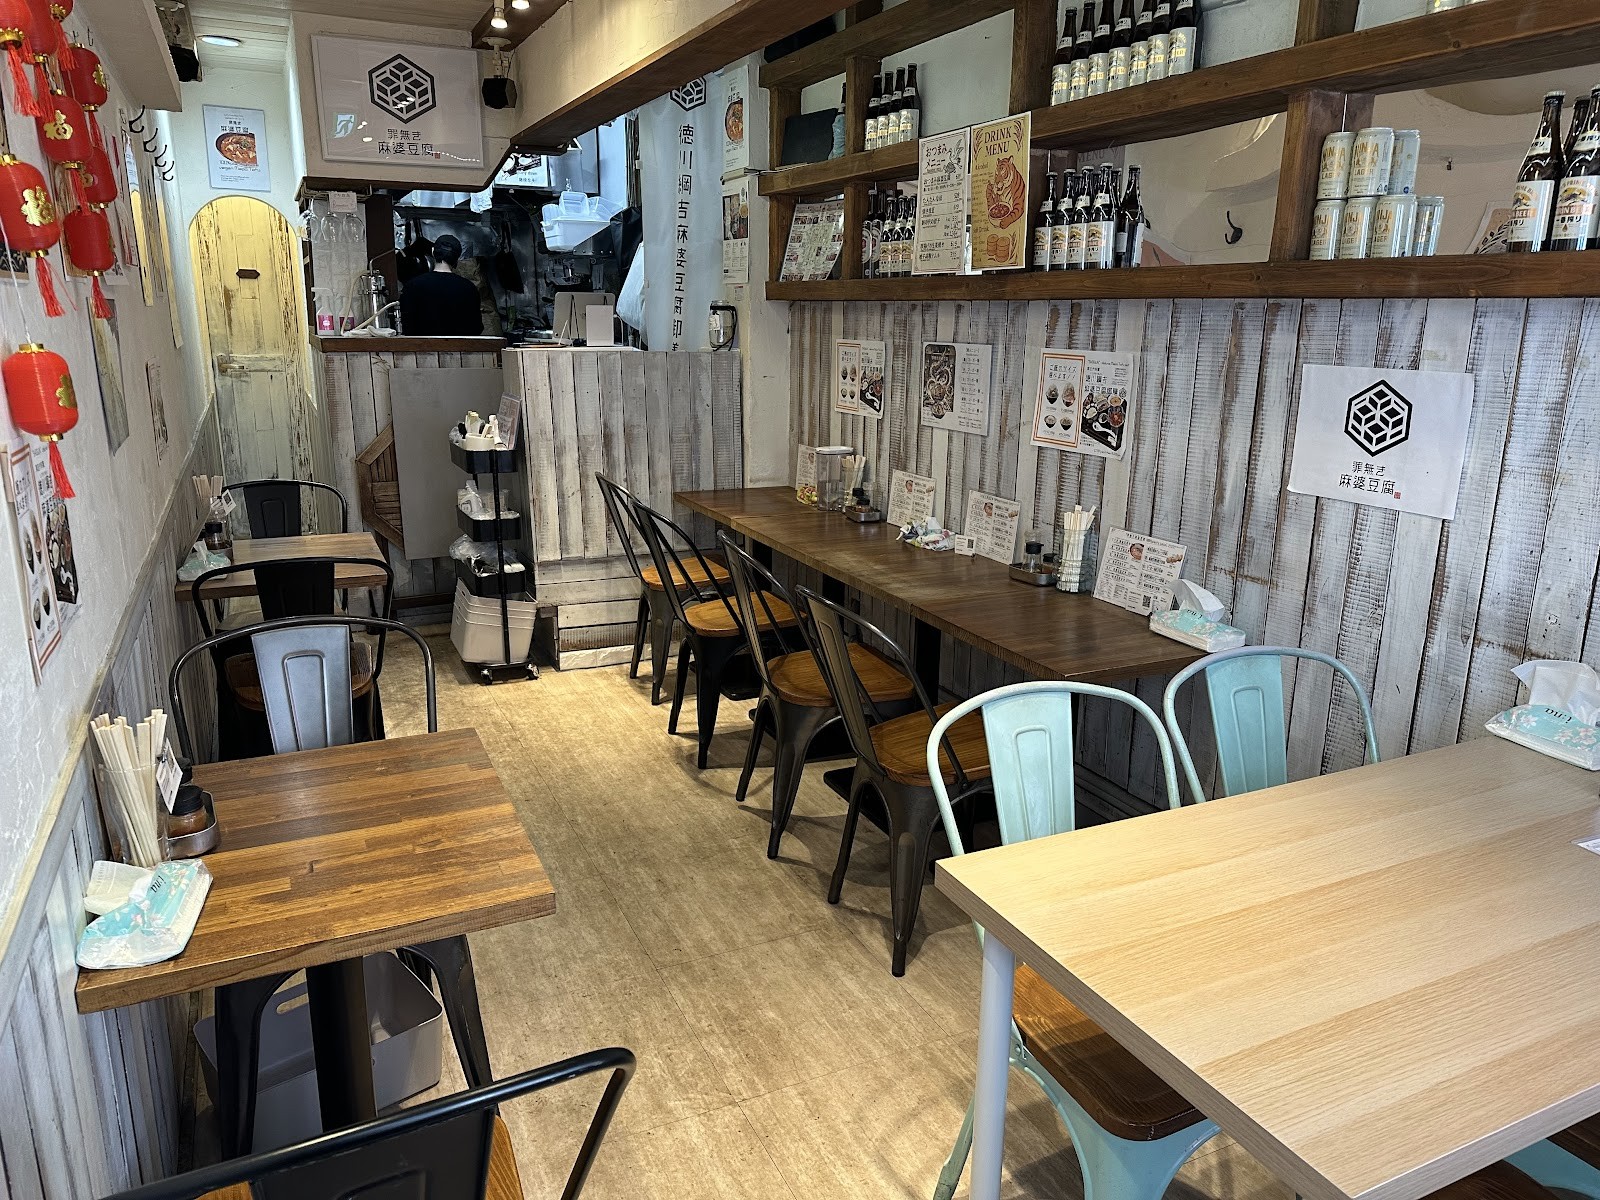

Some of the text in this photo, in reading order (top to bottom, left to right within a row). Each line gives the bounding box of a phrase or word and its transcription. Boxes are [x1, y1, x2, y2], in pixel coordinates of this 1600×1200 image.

[984, 127, 1012, 143] DRINK
[378, 141, 434, 156] 麻婆豆腐
[985, 141, 1010, 157] MENU
[1355, 142, 1379, 158] NINA
[925, 158, 946, 169] メニュー
[1556, 215, 1582, 224] 一番搾り
[1352, 461, 1386, 477] 罪無き
[1338, 474, 1397, 496] 麻婆豆腐
